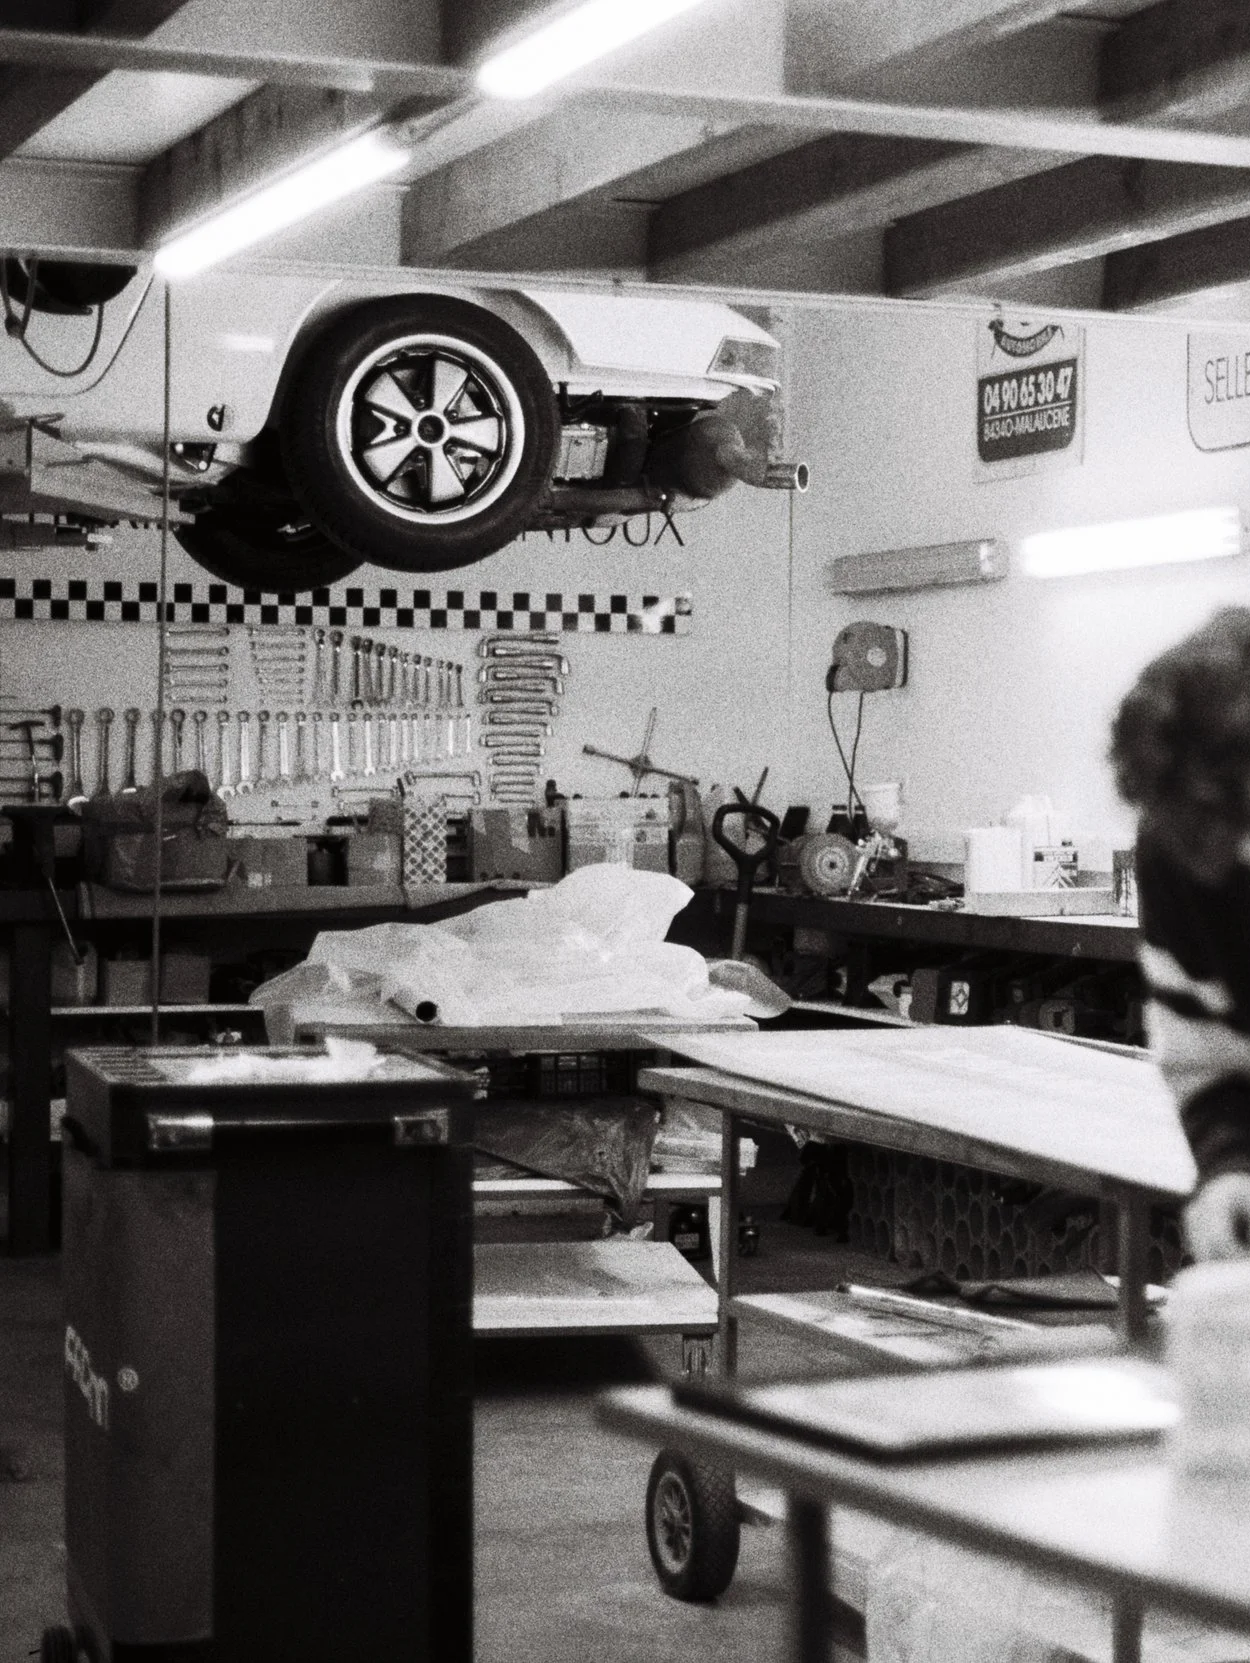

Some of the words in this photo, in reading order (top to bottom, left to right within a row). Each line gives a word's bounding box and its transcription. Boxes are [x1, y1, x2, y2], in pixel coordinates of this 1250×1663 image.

[984, 383, 1000, 415] 04
[1002, 378, 1018, 411] 90
[1020, 374, 1035, 407] 65
[1037, 370, 1054, 404] 30
[1056, 366, 1073, 399] 47
